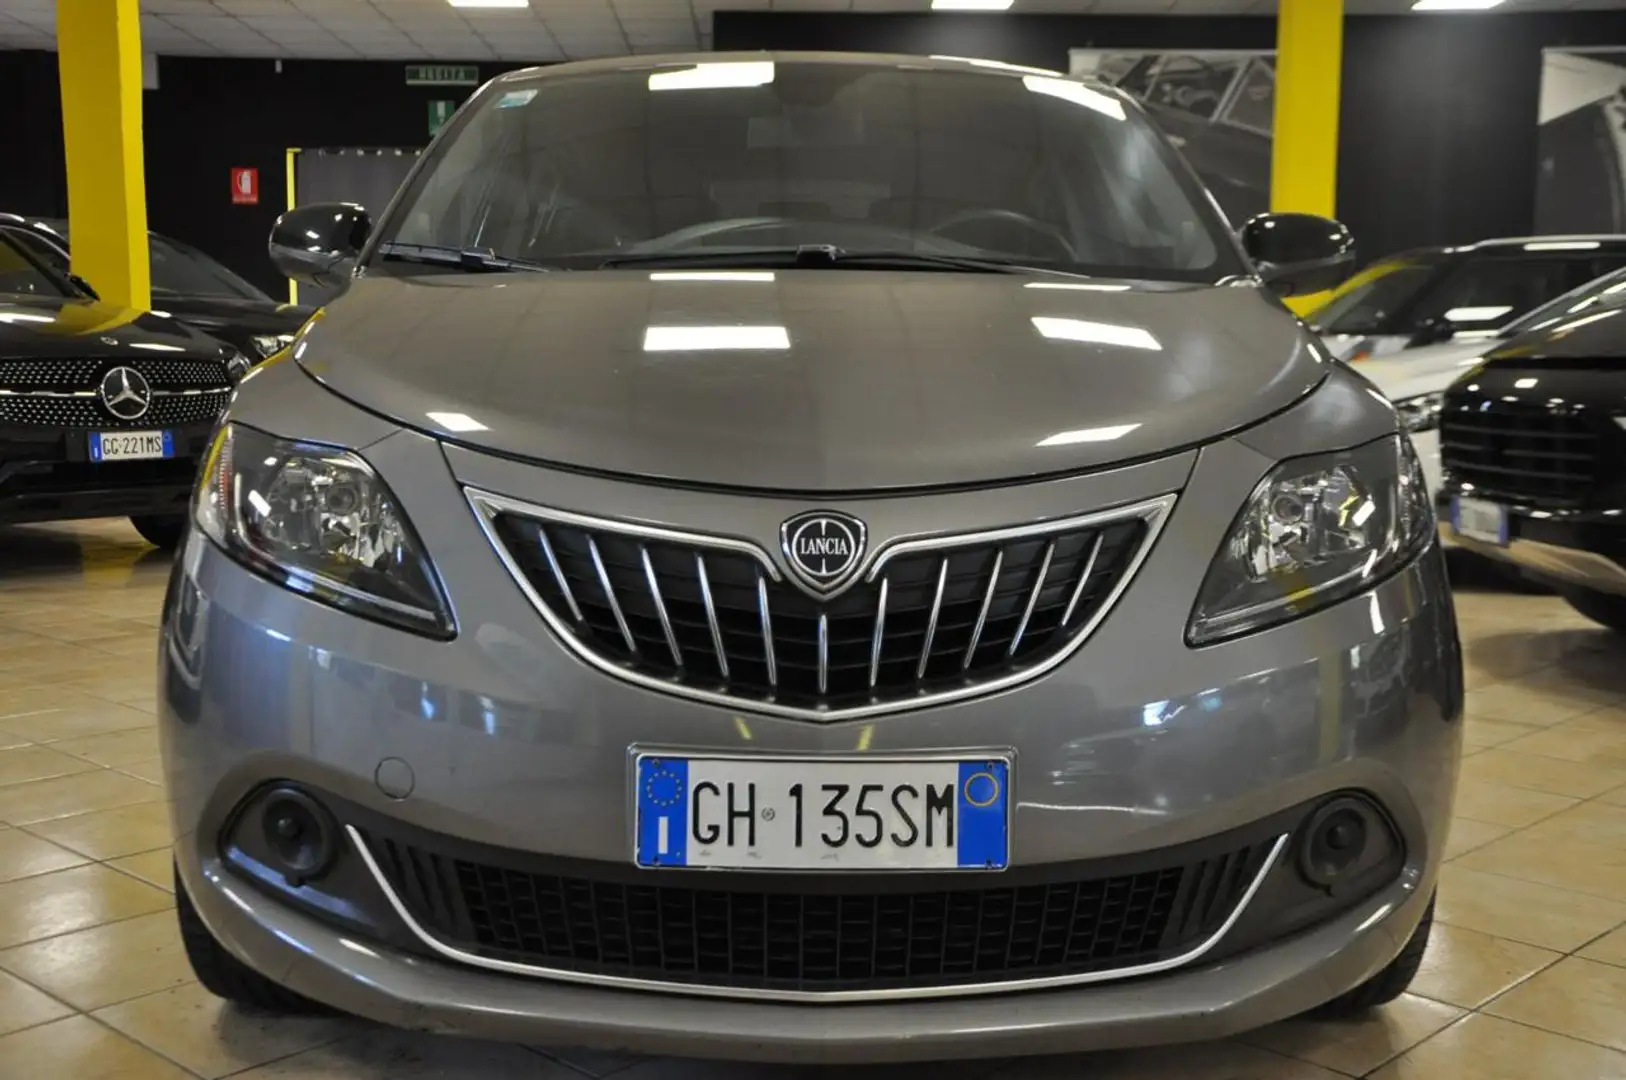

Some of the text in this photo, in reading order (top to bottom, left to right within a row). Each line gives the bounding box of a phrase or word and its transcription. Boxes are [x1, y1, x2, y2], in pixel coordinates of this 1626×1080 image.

[800, 537, 849, 555] LANCIA
[692, 781, 955, 849] GH 135SM
